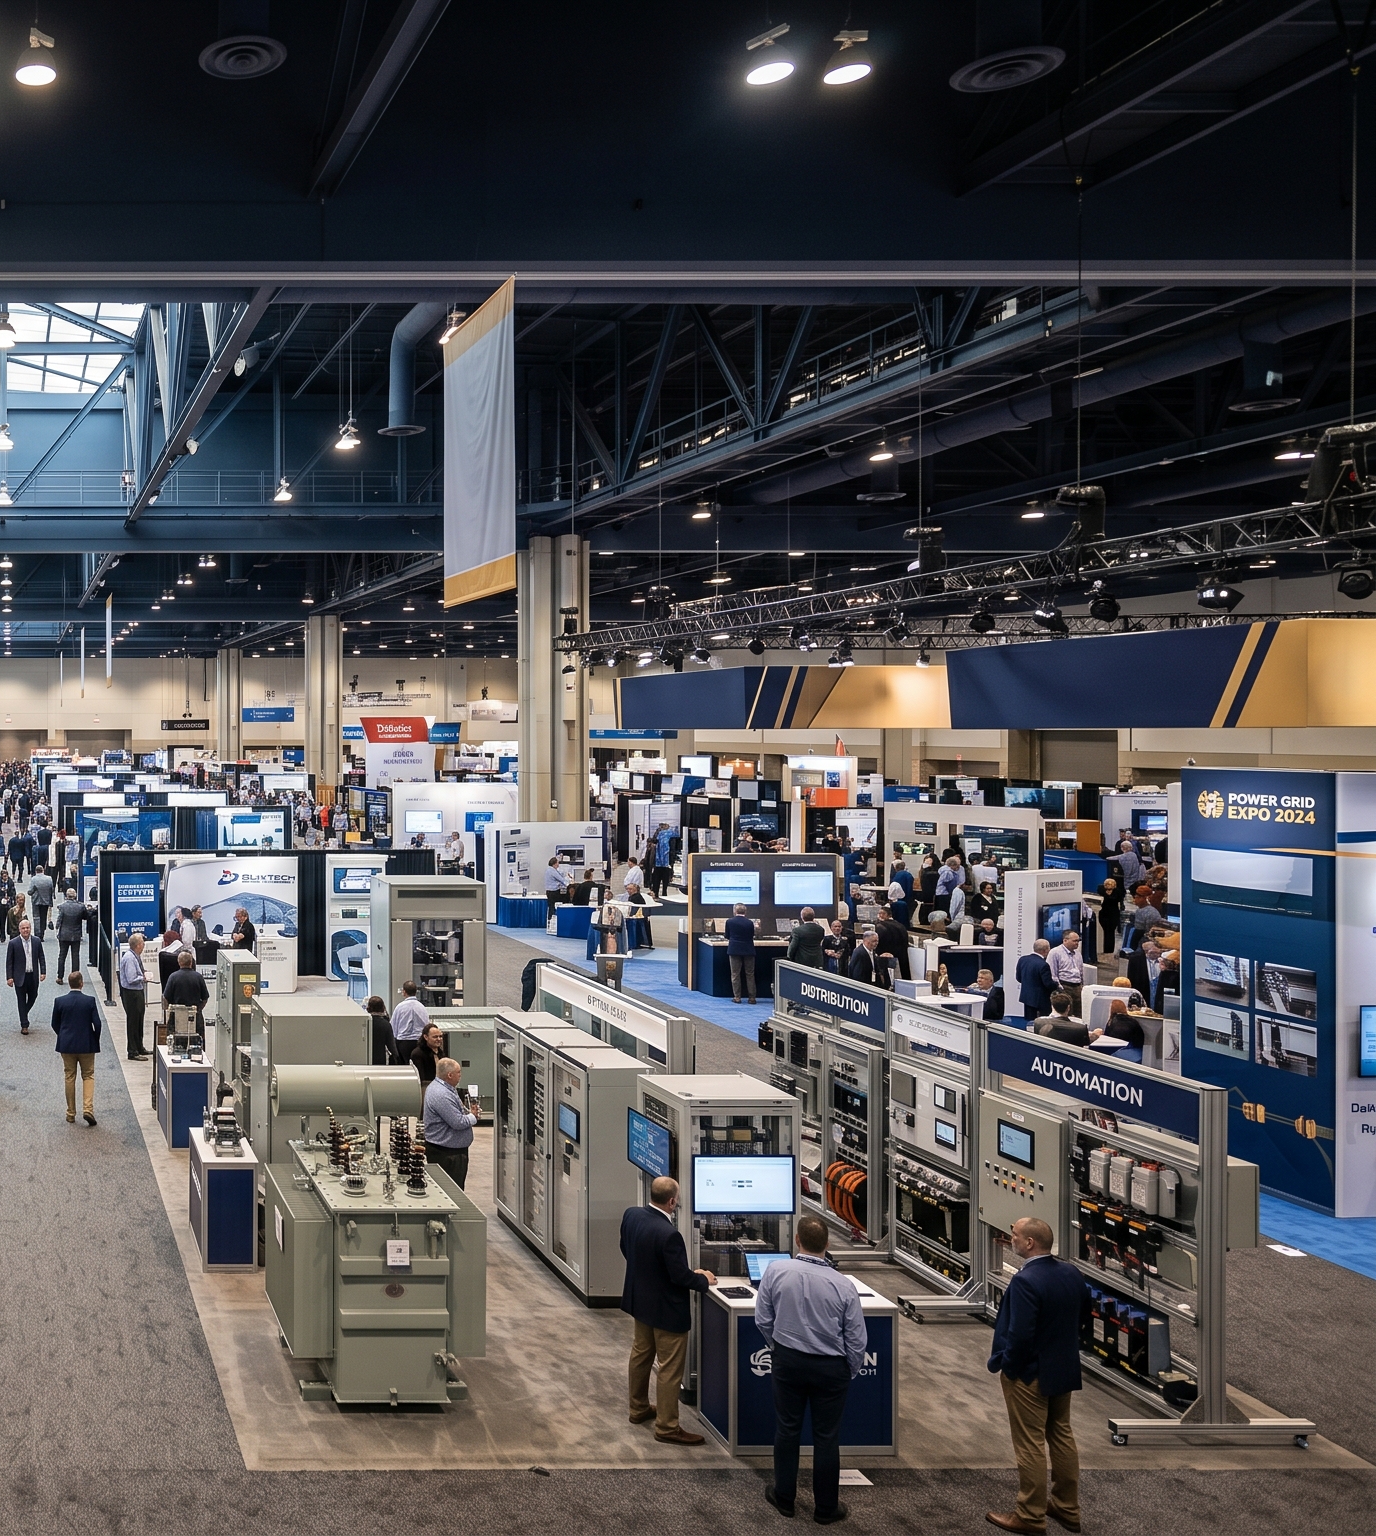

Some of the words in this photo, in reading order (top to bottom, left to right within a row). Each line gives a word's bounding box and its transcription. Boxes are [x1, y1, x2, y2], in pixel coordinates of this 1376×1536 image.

[1228, 793, 1278, 806] POWER
[1280, 795, 1316, 809] GRID
[1227, 805, 1271, 822] EXPO
[1274, 808, 1316, 825] 2024
[1031, 1056, 1143, 1107] AUTOMATION
